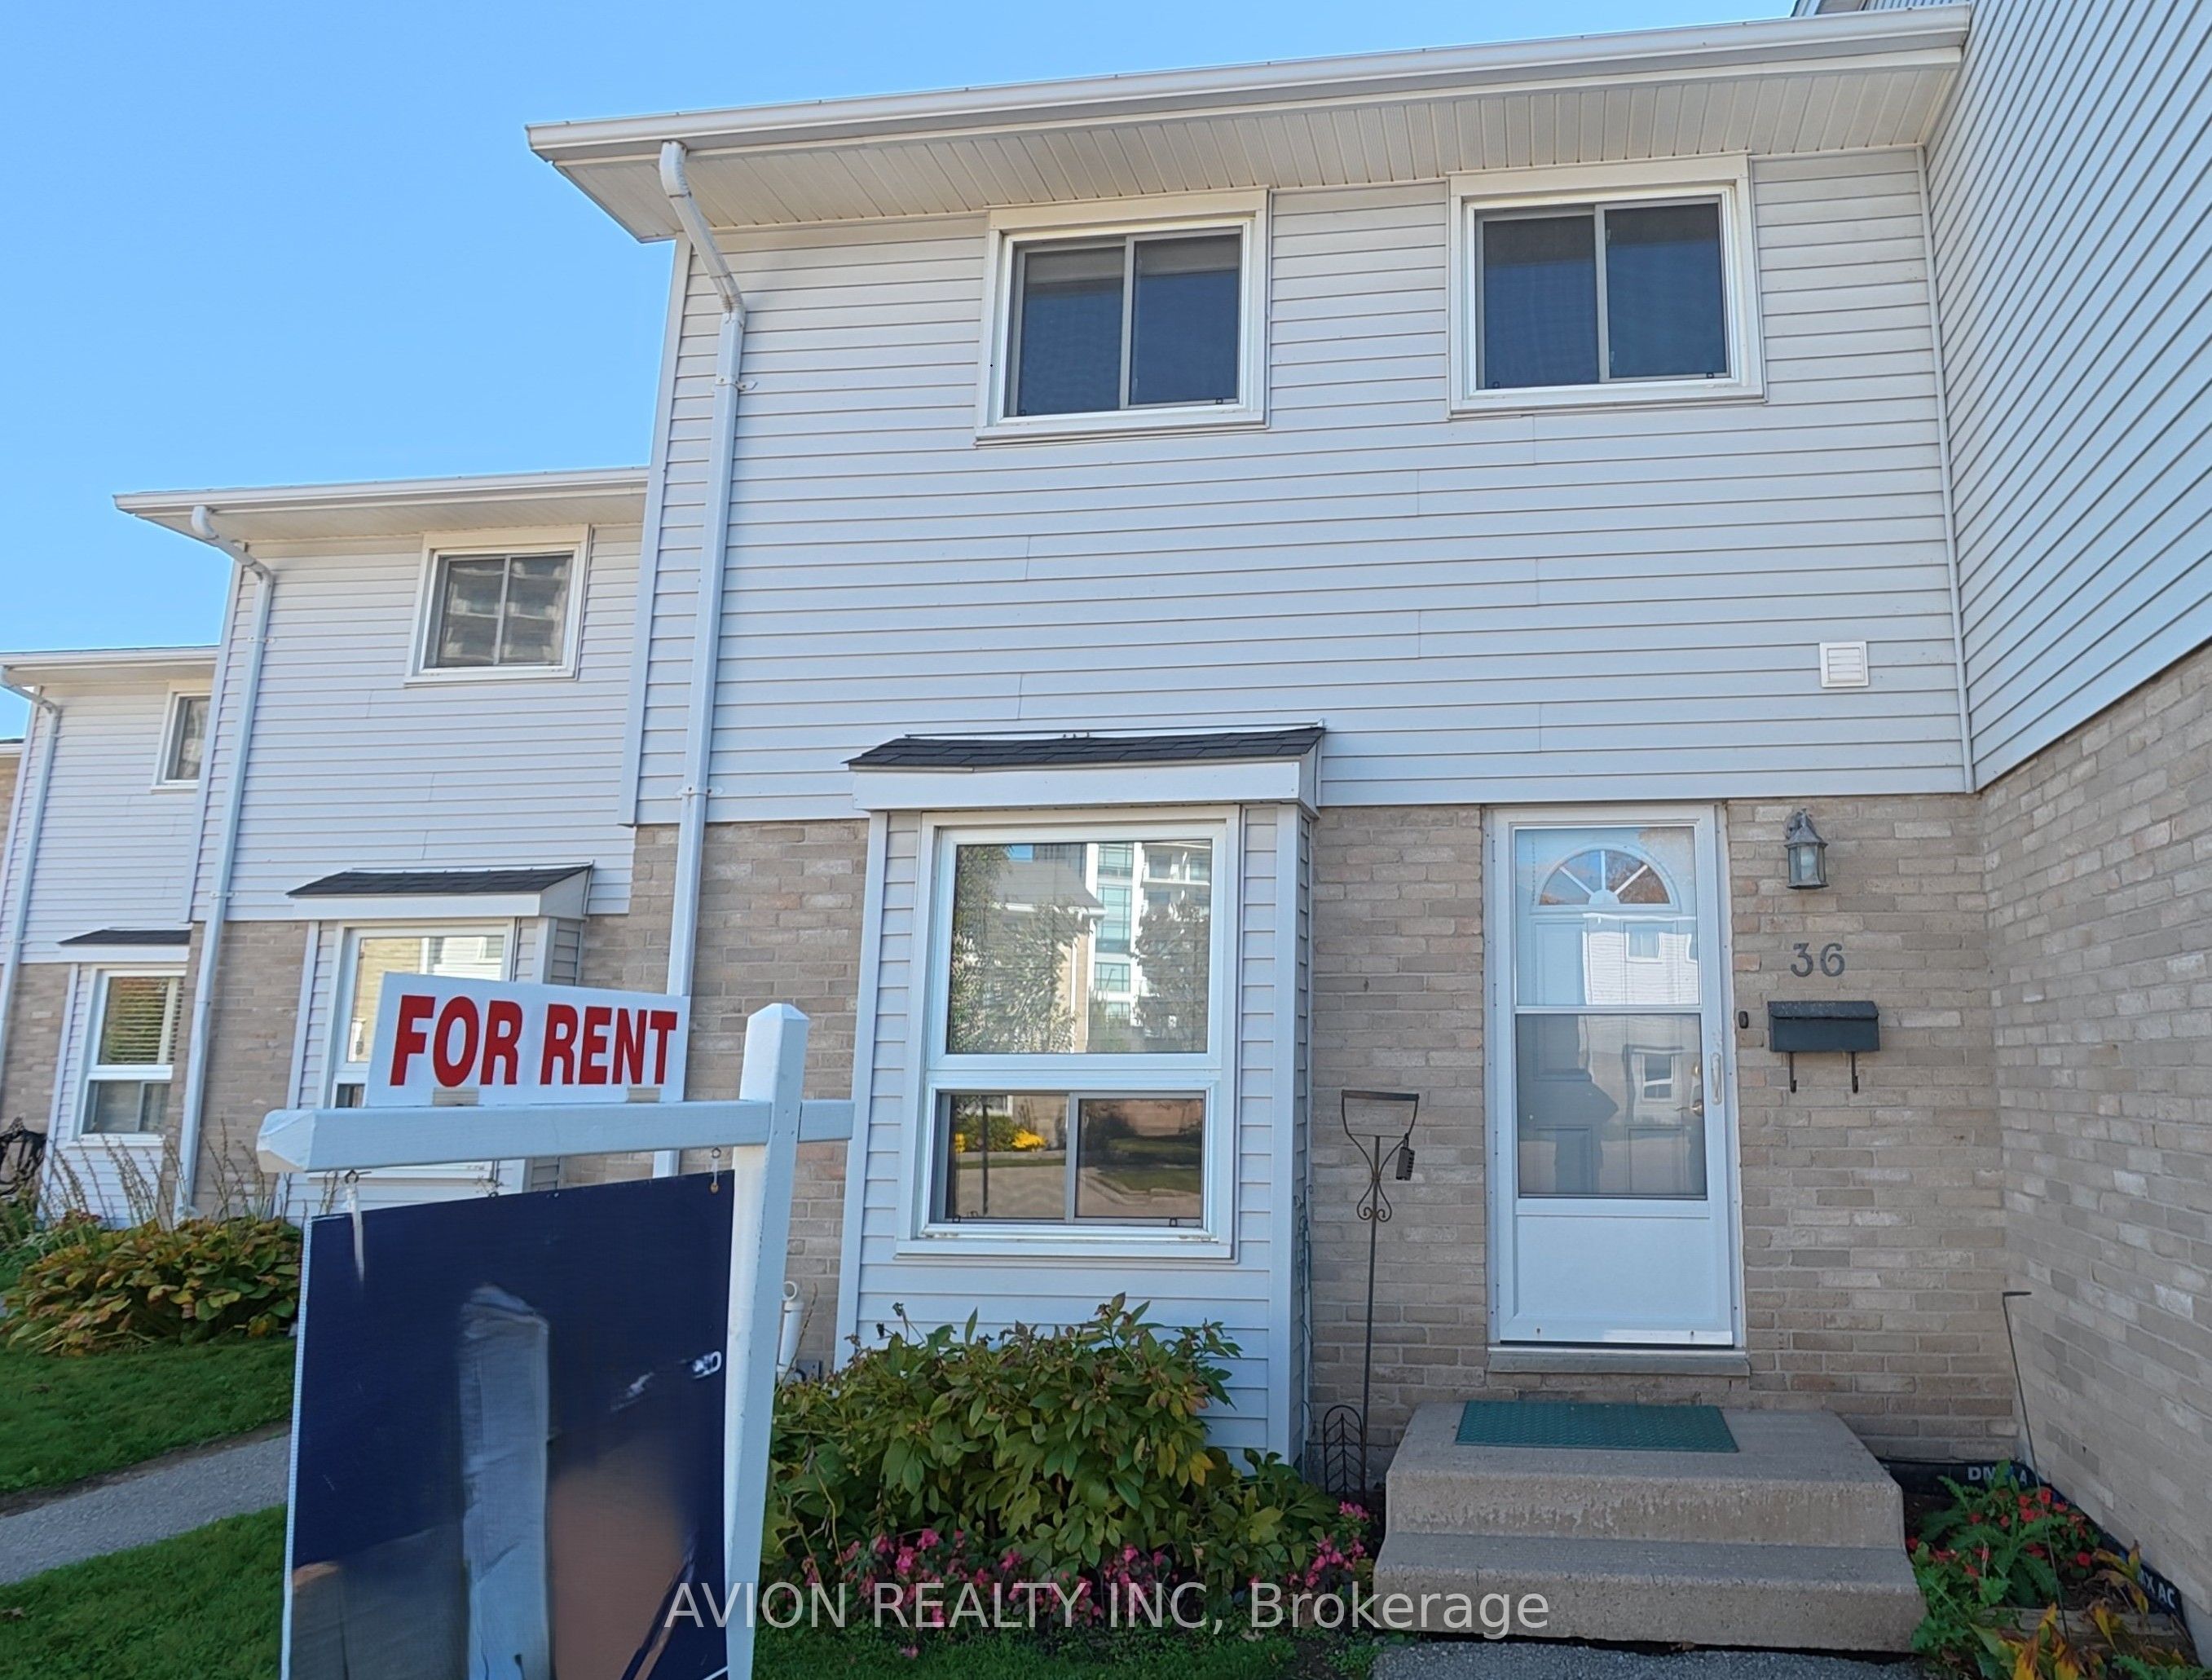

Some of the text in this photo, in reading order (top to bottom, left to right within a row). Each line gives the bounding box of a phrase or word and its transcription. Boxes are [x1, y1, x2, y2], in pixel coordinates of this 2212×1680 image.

[1791, 942, 1845, 977] 36
[390, 994, 678, 1087] FOR RENT
